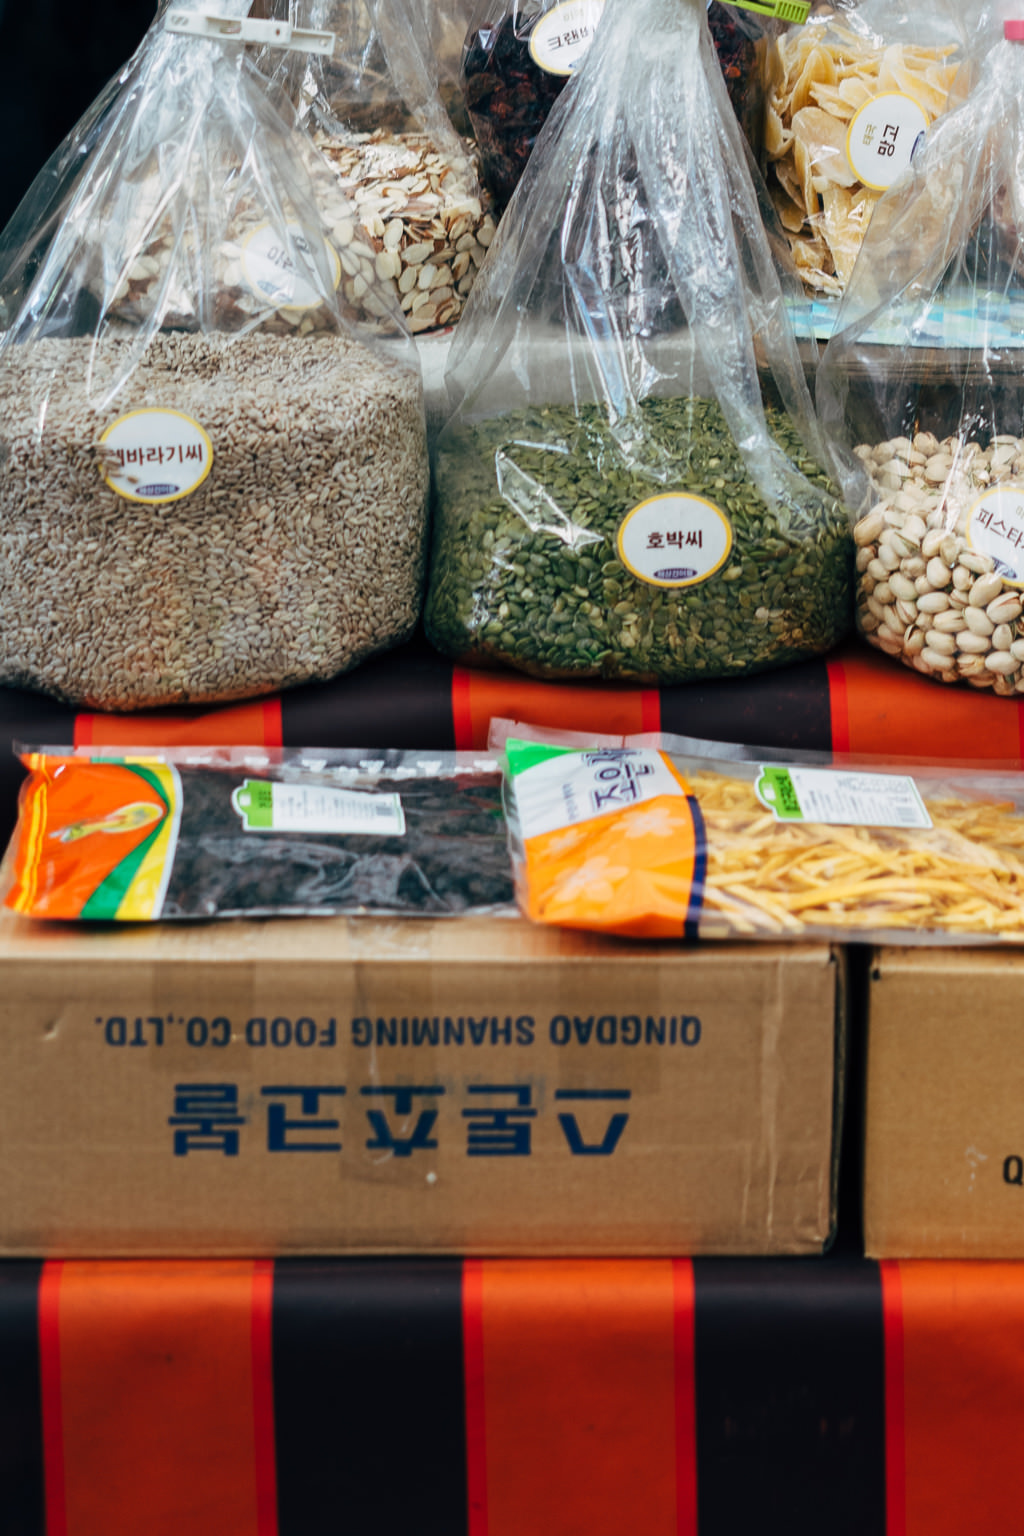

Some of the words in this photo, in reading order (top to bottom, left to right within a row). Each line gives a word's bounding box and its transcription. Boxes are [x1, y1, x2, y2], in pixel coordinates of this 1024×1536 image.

[877, 124, 900, 157] 망고
[646, 529, 703, 550] 호박씨
[245, 1016, 337, 1048] FOOD
[351, 1015, 535, 1049] SHANMING
[549, 1014, 702, 1047] QINGDAO
[169, 1083, 631, 1157] 스톤초코볼
